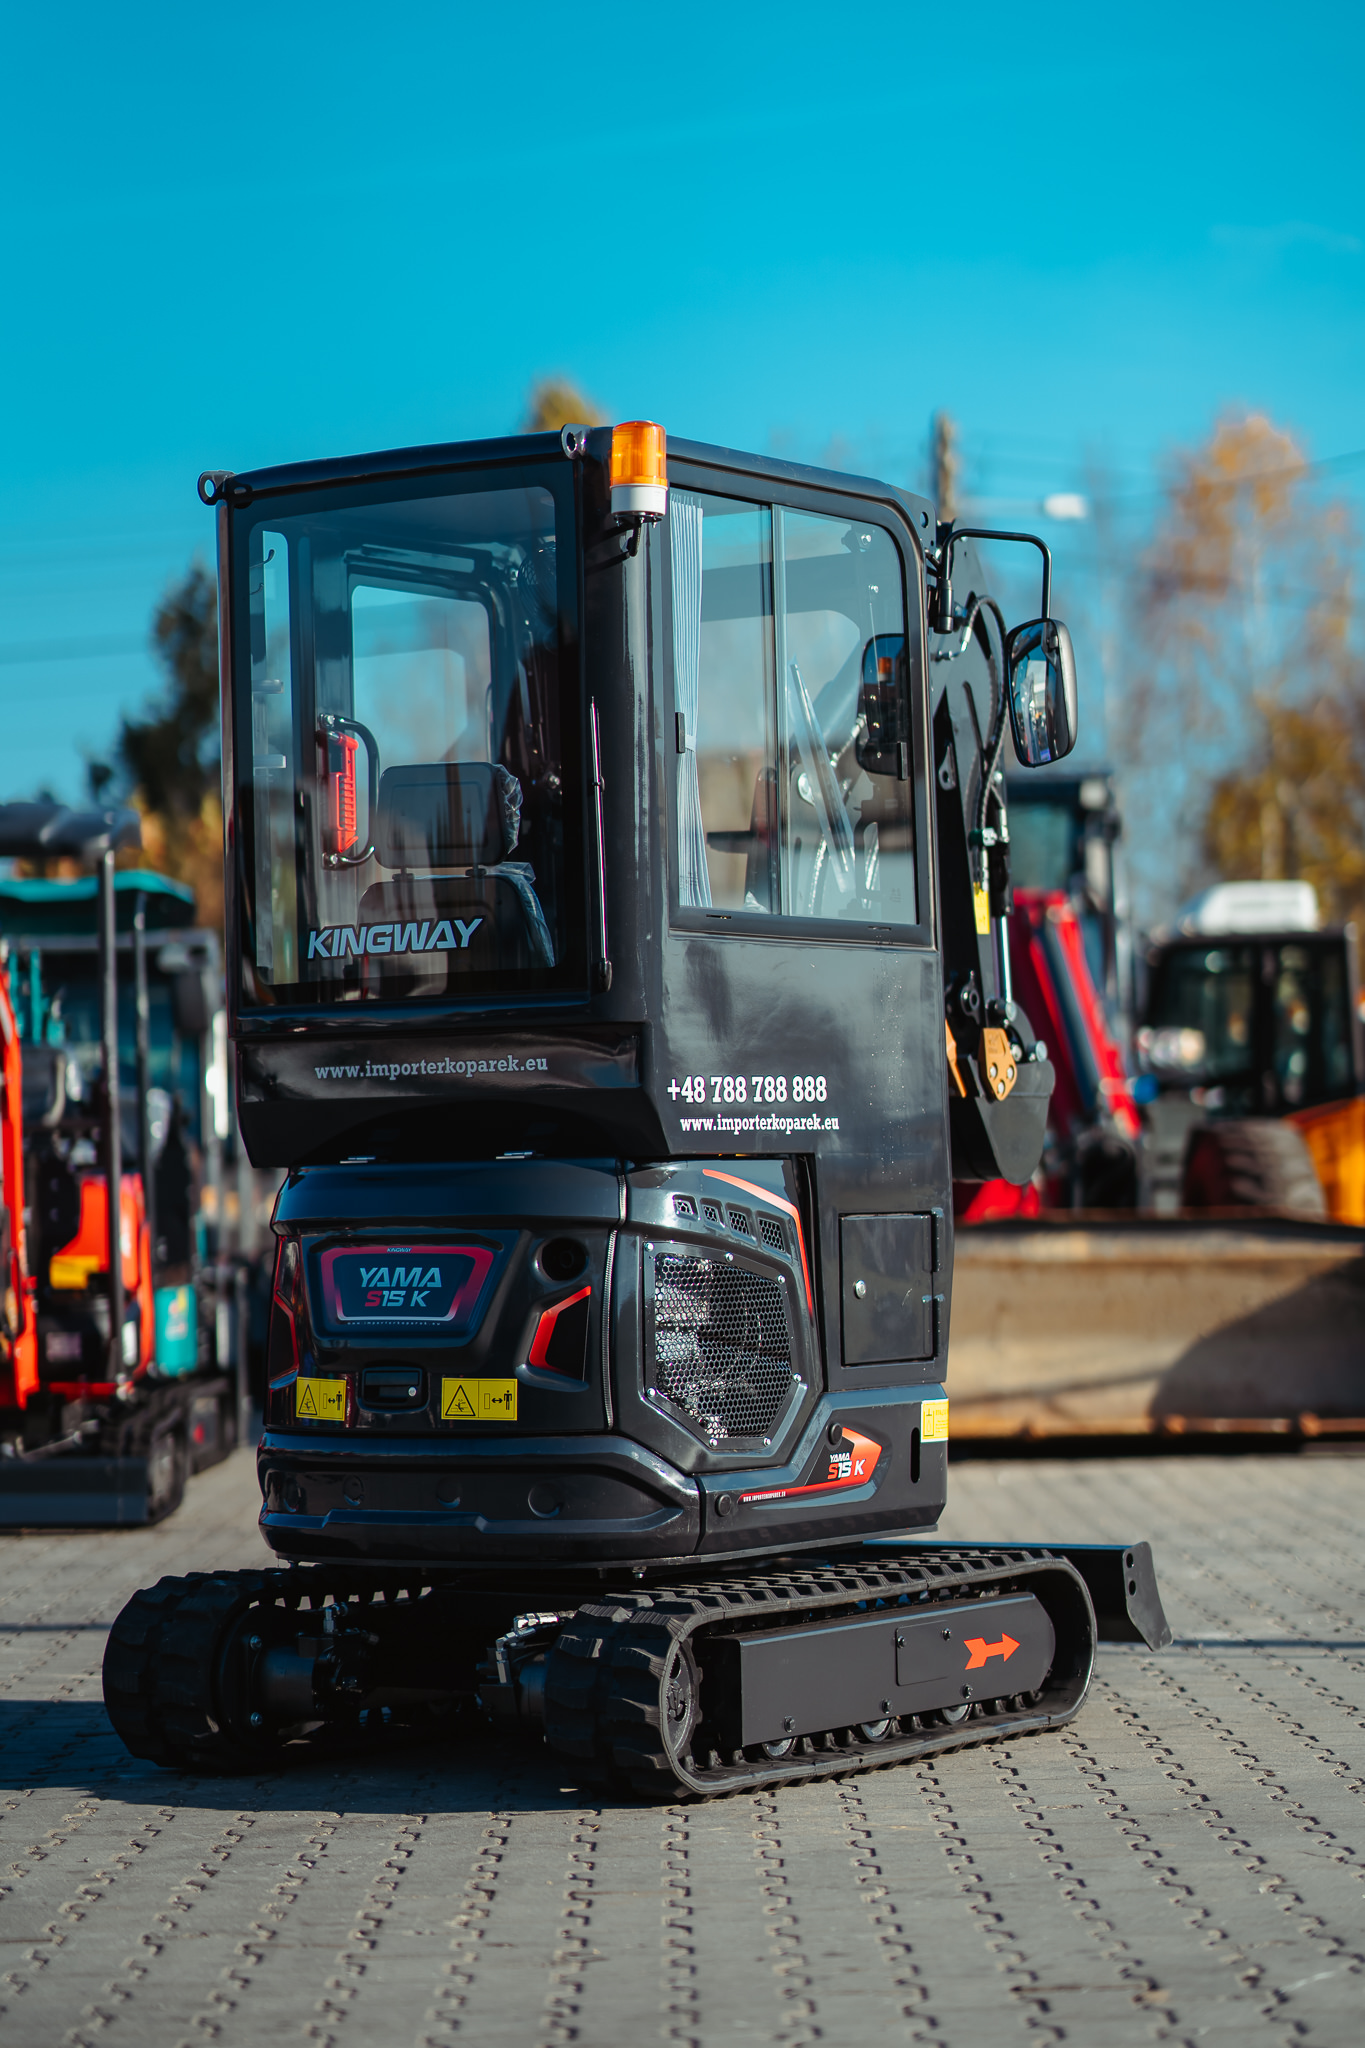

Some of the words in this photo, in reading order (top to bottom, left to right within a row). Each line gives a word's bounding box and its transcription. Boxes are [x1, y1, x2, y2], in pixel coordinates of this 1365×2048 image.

[307, 918, 483, 960] KINGWAY
[315, 1054, 548, 1080] www.importerkoparek.eu
[667, 1075, 707, 1103] +48
[710, 1075, 747, 1103] 788
[751, 1075, 788, 1103] 788
[792, 1075, 828, 1103] 888
[680, 1113, 840, 1135] www.importerkoparek.eu
[360, 1267, 442, 1288] YAMA
[364, 1290, 407, 1307] S15
[410, 1290, 431, 1307] K
[830, 1452, 851, 1463] YAMA
[827, 1461, 853, 1480] S15
[854, 1459, 867, 1477] K
